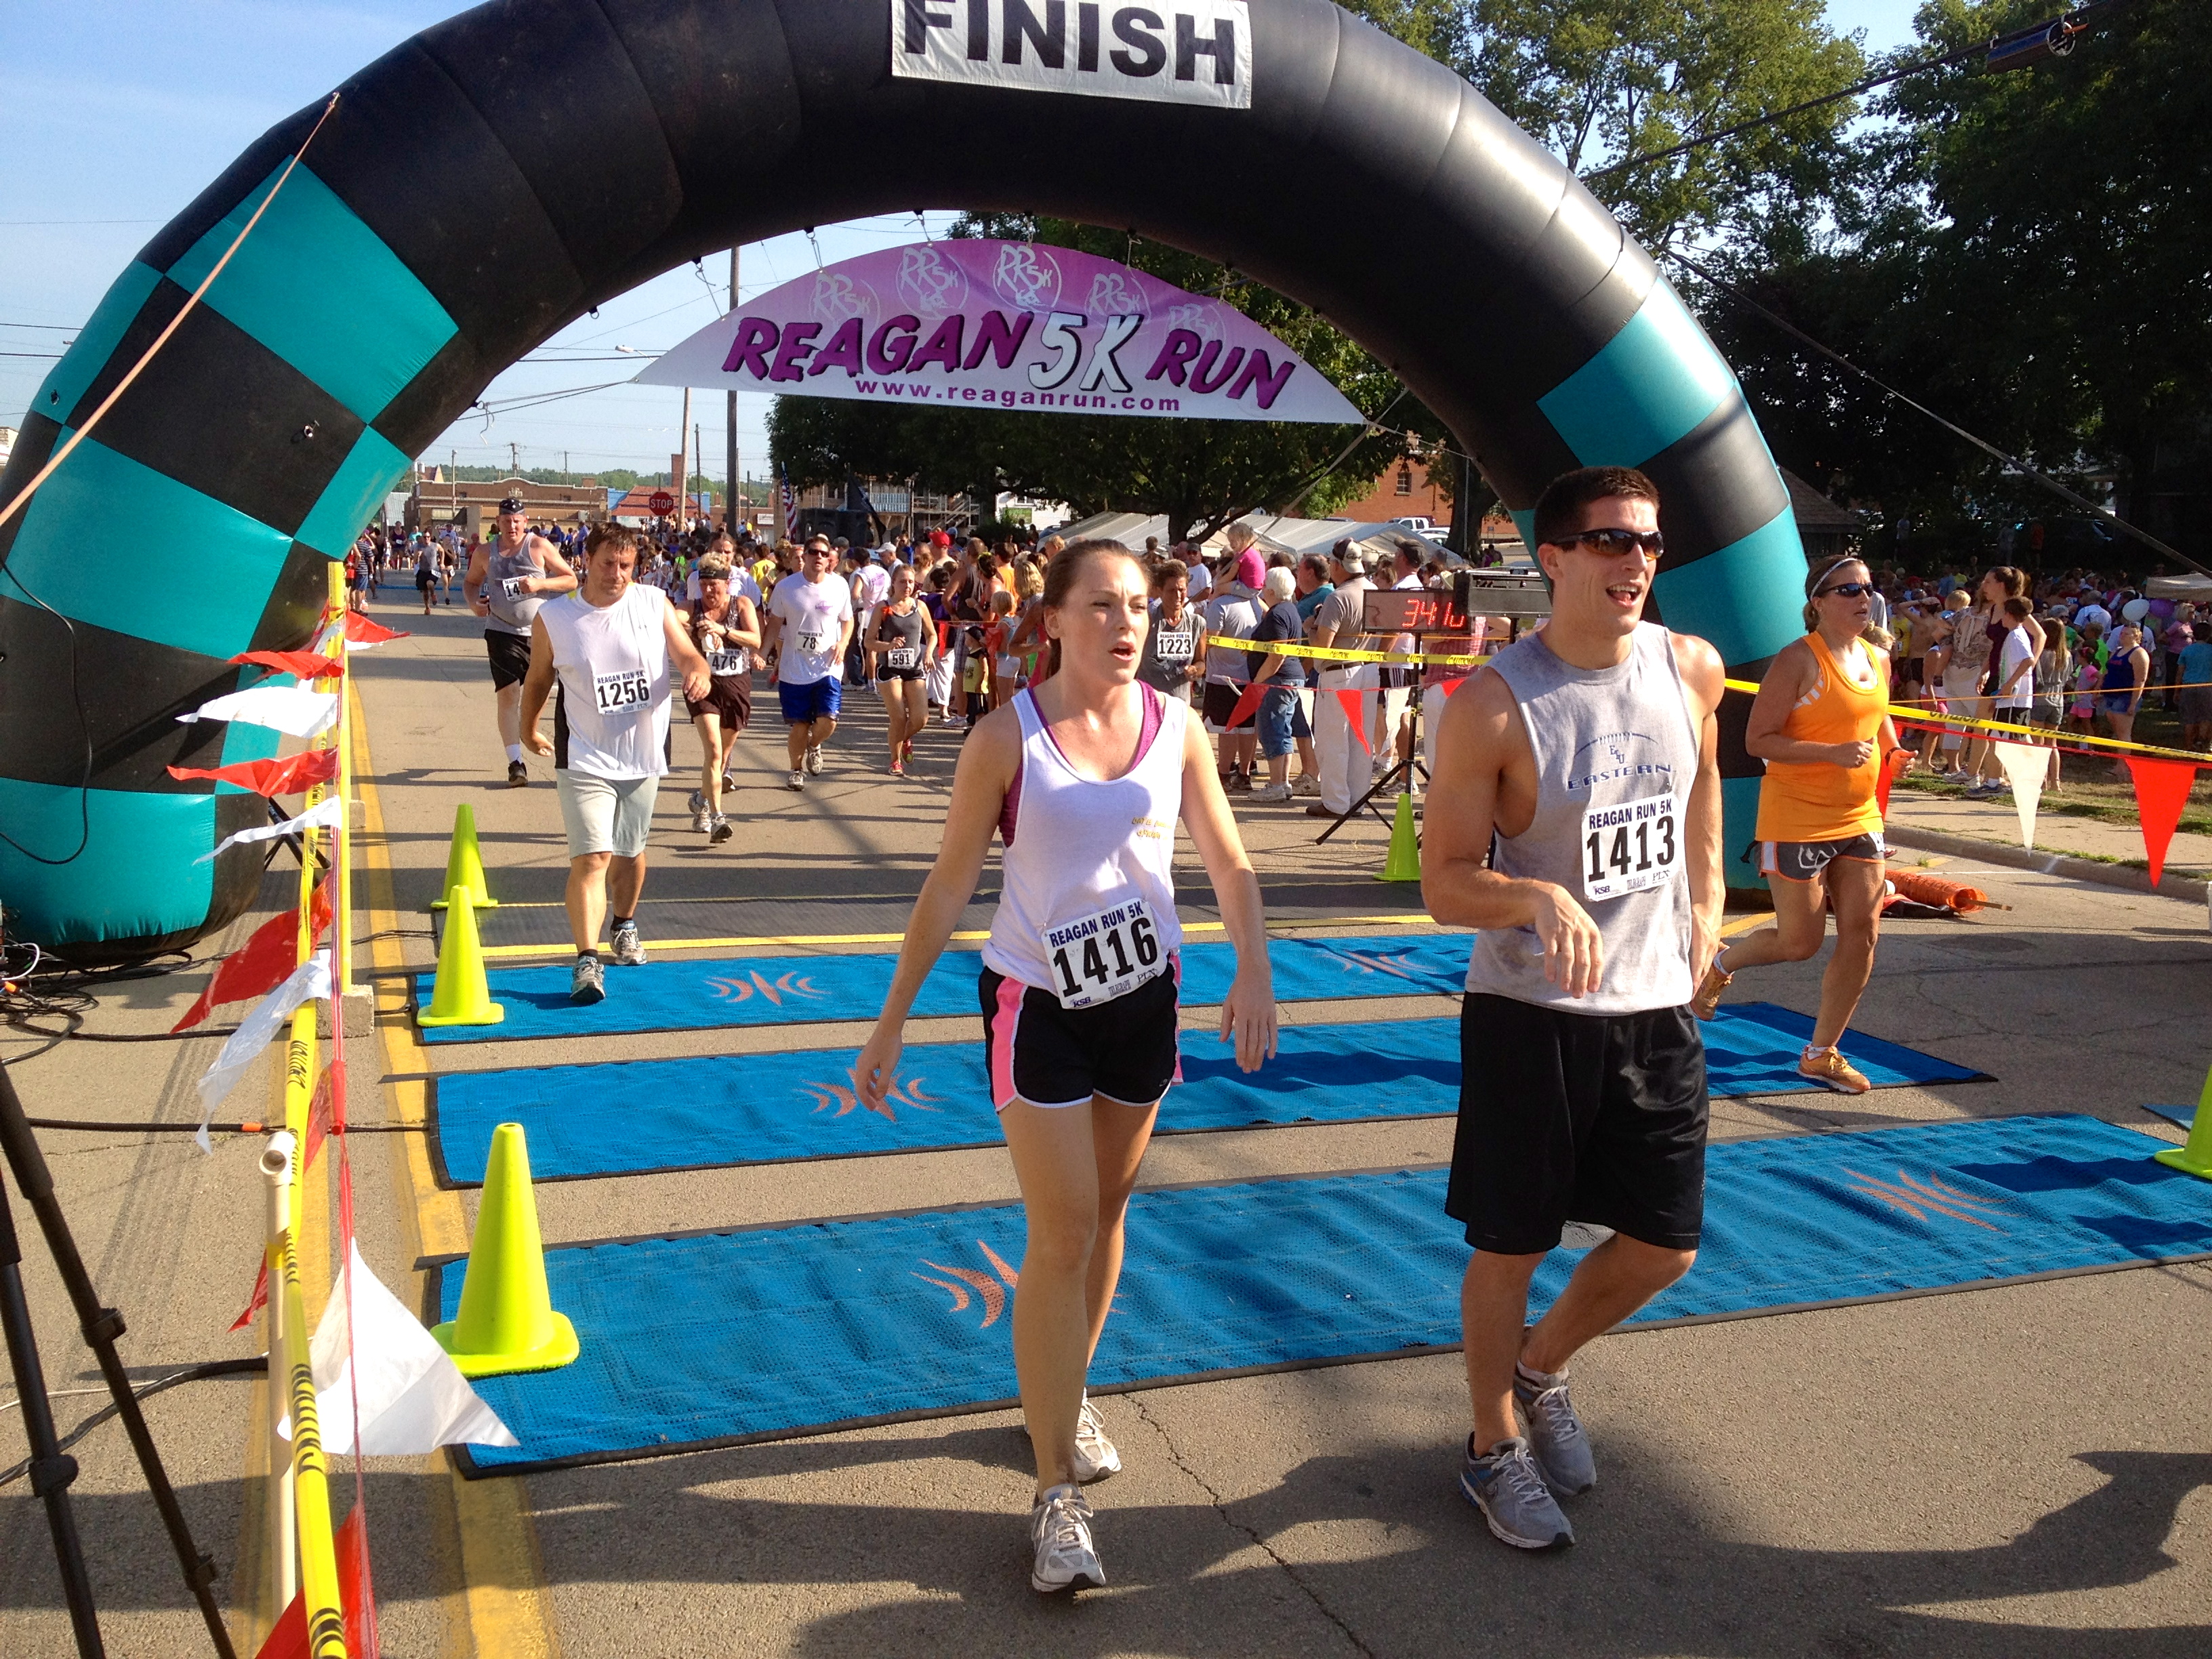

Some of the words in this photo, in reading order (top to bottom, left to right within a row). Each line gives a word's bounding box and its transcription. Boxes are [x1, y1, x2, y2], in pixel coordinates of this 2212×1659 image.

[904, 0, 1235, 85] FINISH
[722, 310, 1036, 384] REAGAN
[1027, 311, 1145, 393] 5K
[1145, 329, 1296, 409] RUN
[855, 380, 1180, 411] www.reaganrun.com
[651, 498, 673, 509] STOP
[803, 636, 816, 649] 78
[1160, 639, 1191, 654] 1223
[712, 655, 737, 670] 476
[893, 654, 910, 665] 591
[597, 675, 620, 684] REAGAN
[622, 672, 634, 680] RUN
[598, 678, 649, 708] 1256
[1568, 764, 1671, 789] EASTERN
[1589, 807, 1632, 830] REAGAN
[1637, 802, 1656, 820] RUN
[1660, 798, 1672, 814] 5K
[1586, 815, 1675, 882] 1413
[1049, 918, 1098, 947] REAGAN
[1101, 908, 1126, 929] RUN
[1128, 900, 1144, 918] 5K
[1053, 917, 1158, 998] 1416
